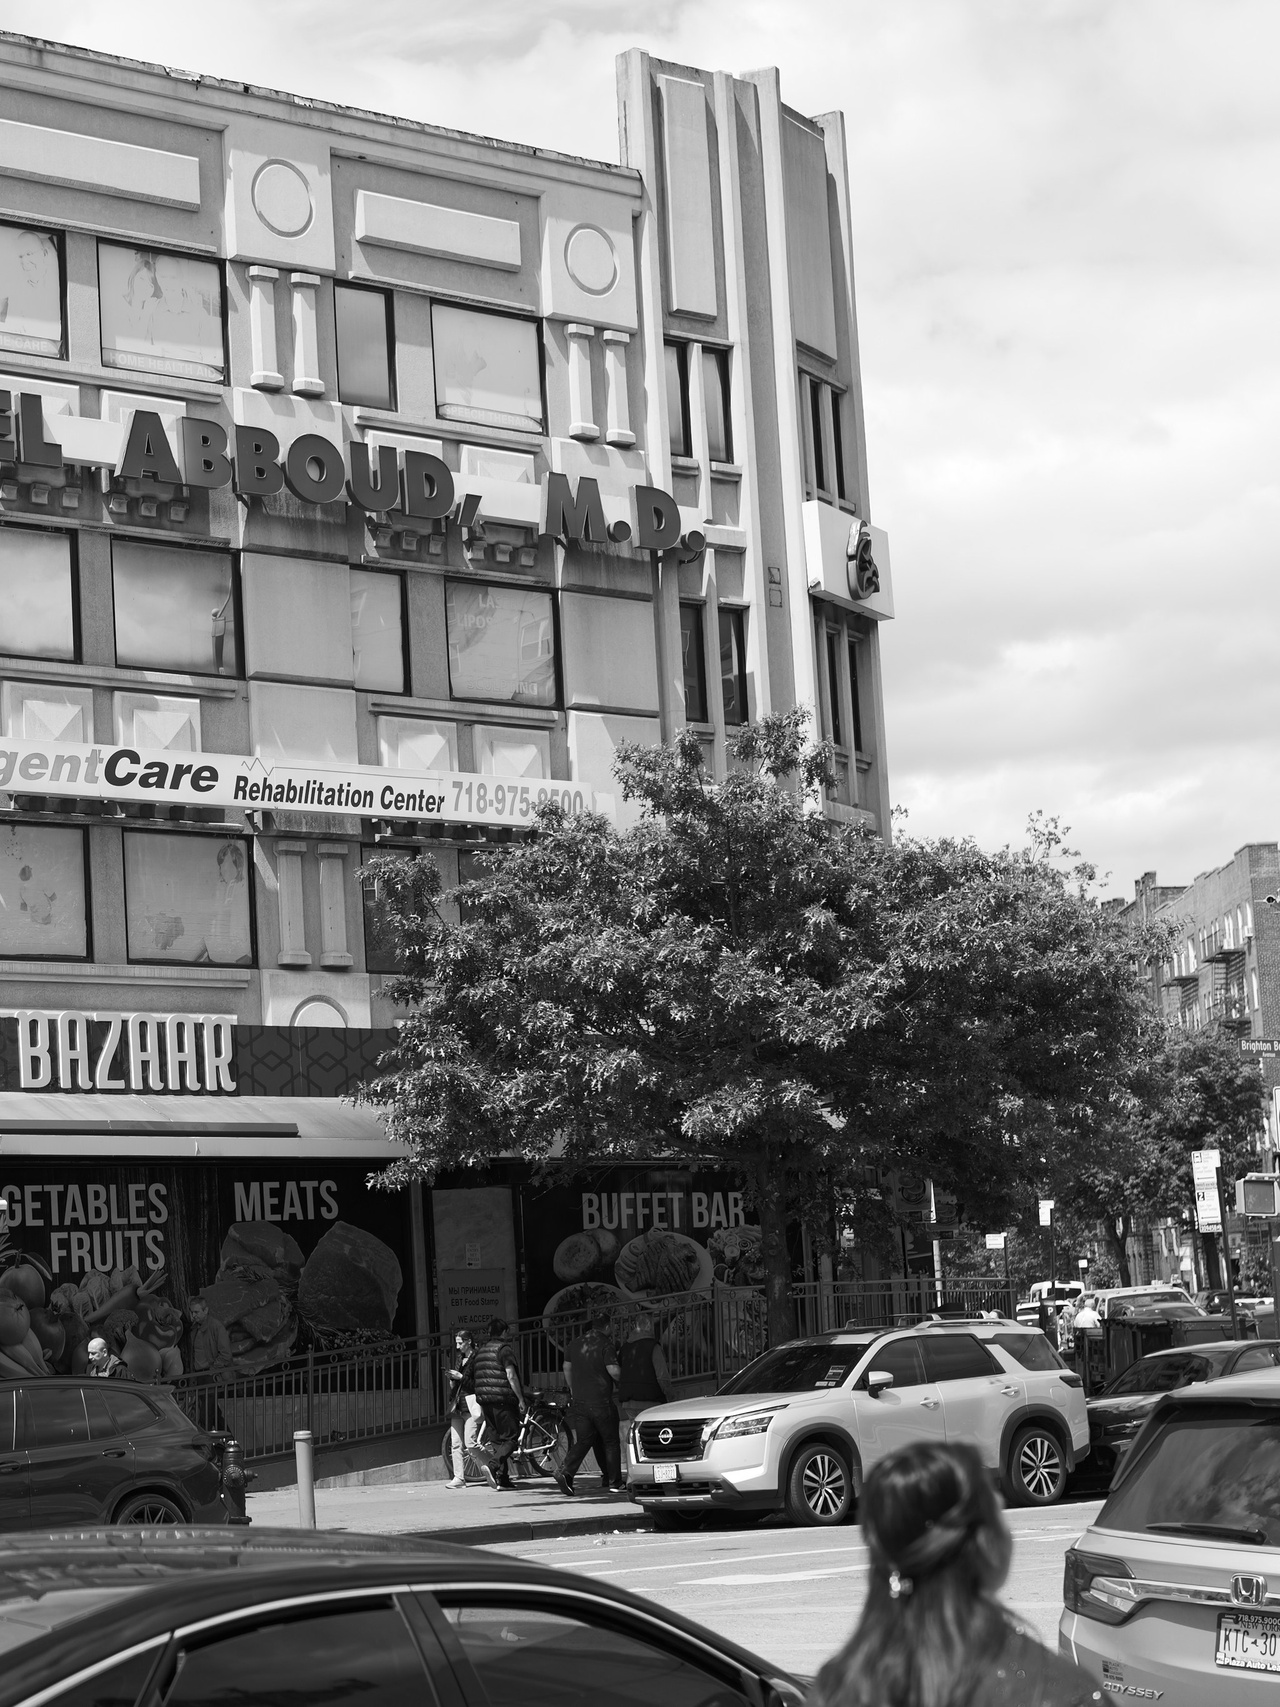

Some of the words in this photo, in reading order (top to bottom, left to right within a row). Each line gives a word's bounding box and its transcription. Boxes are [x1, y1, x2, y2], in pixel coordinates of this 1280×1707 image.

[11, 336, 49, 353] CARE
[109, 352, 147, 369] HOME
[148, 356, 194, 375] HEALTH
[115, 409, 483, 524] ABBOUD,
[540, 471, 705, 564] M.D.
[233, 774, 374, 810] Rehabilitation
[380, 785, 446, 814] Center
[14, 1009, 238, 1092] BAZAAR
[1241, 1039, 1272, 1054] Brighton
[233, 1179, 340, 1222] MEATS
[1198, 1192, 1205, 1201] 2
[581, 1191, 684, 1230] BUFFET
[691, 1191, 746, 1229] BAR
[50, 1229, 166, 1273] FRUITS
[461, 1285, 500, 1295] ПРИНИМАЕМ
[451, 1298, 463, 1307] EBT
[464, 1298, 480, 1306] Food
[480, 1297, 499, 1307] Stamp
[457, 1315, 468, 1323] WE
[469, 1314, 494, 1323] ACCEPT
[1240, 1621, 1260, 1630] NEW
[1224, 1657, 1246, 1667] Plaza
[1246, 1660, 1266, 1670] Auto
[1103, 1681, 1164, 1701] ODYSSEY
